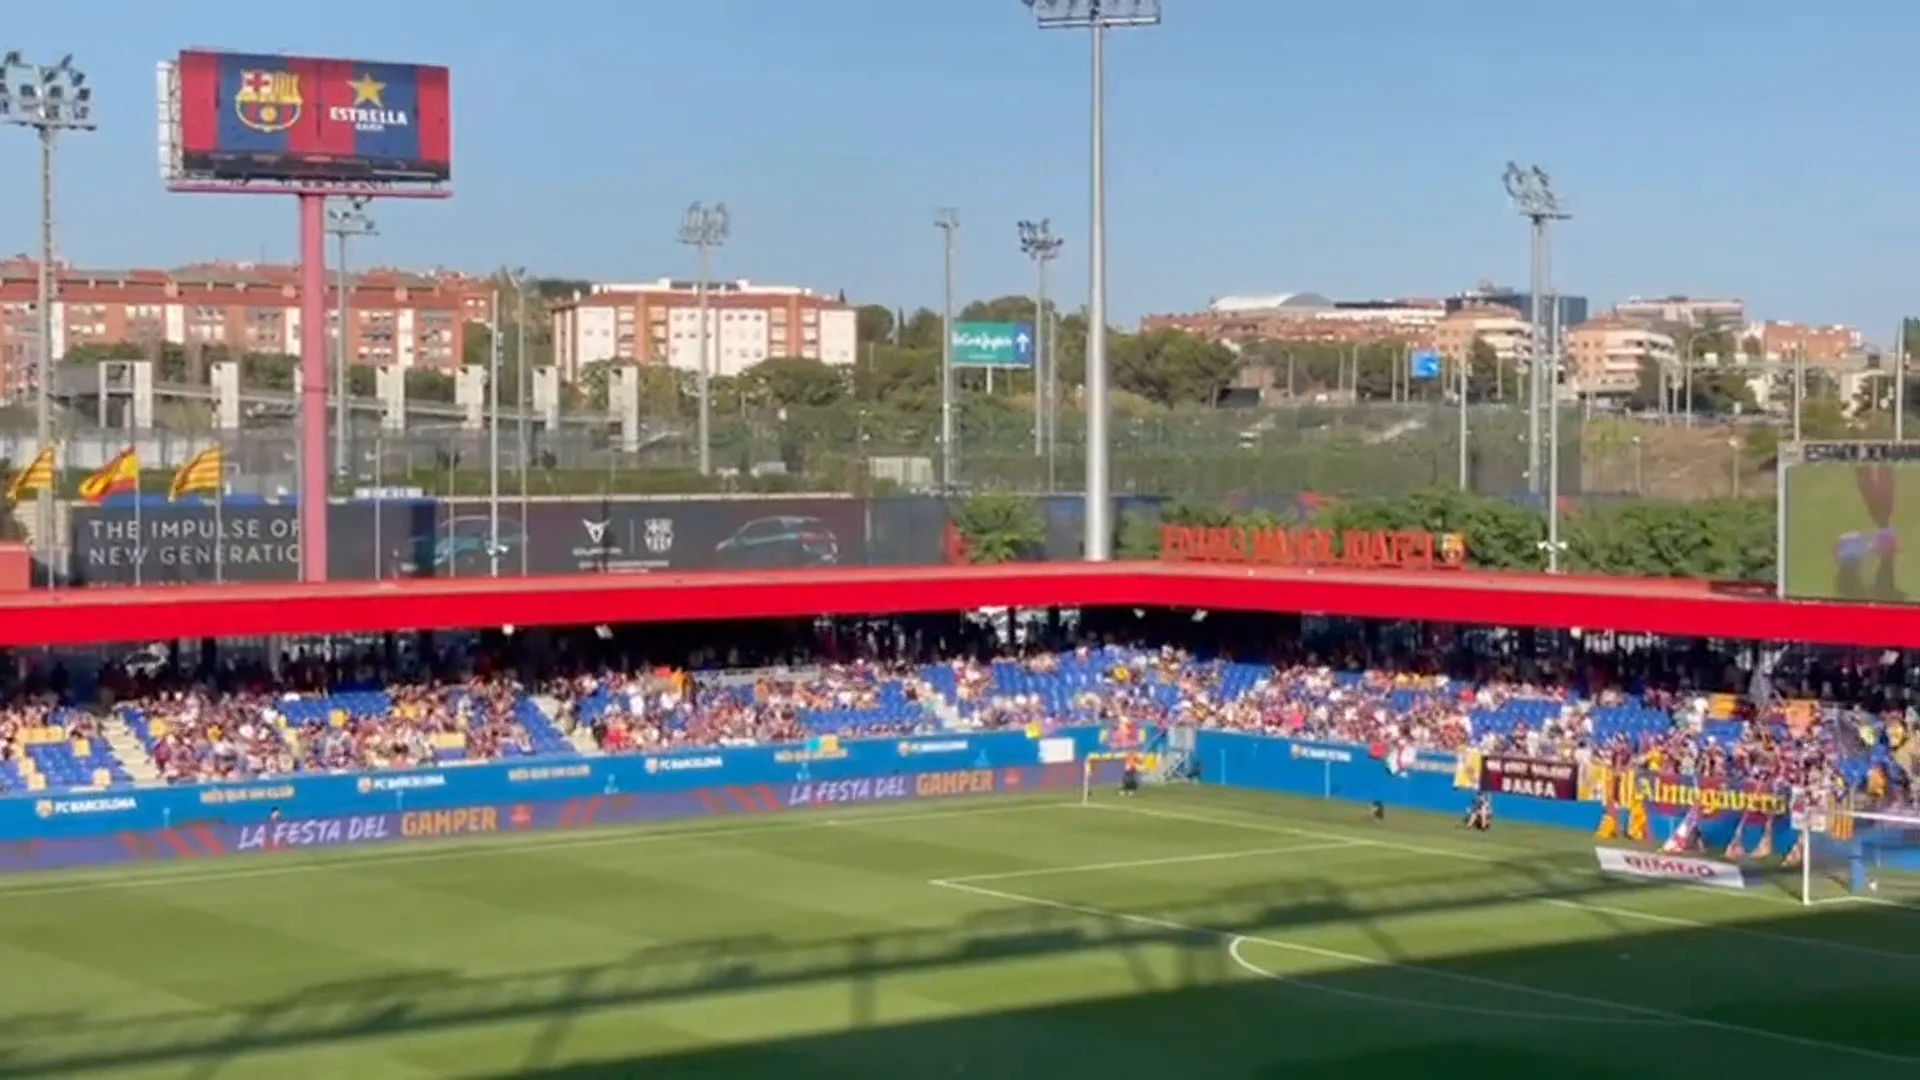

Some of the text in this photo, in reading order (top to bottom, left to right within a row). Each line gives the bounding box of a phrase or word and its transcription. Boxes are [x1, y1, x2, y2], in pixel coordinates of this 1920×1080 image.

[329, 106, 408, 127] ESTRELLA
[88, 519, 138, 540] THE
[151, 518, 262, 540] IMPULSE
[88, 543, 302, 566] NEW GENERATIO
[787, 782, 813, 807] LA
[815, 778, 870, 803] FESTA
[874, 775, 907, 799] DEL
[915, 769, 994, 797] GAMPER
[238, 823, 266, 850] LA
[273, 817, 341, 848] FESTA
[346, 813, 387, 842] DEL
[400, 806, 497, 837] GAMPER
